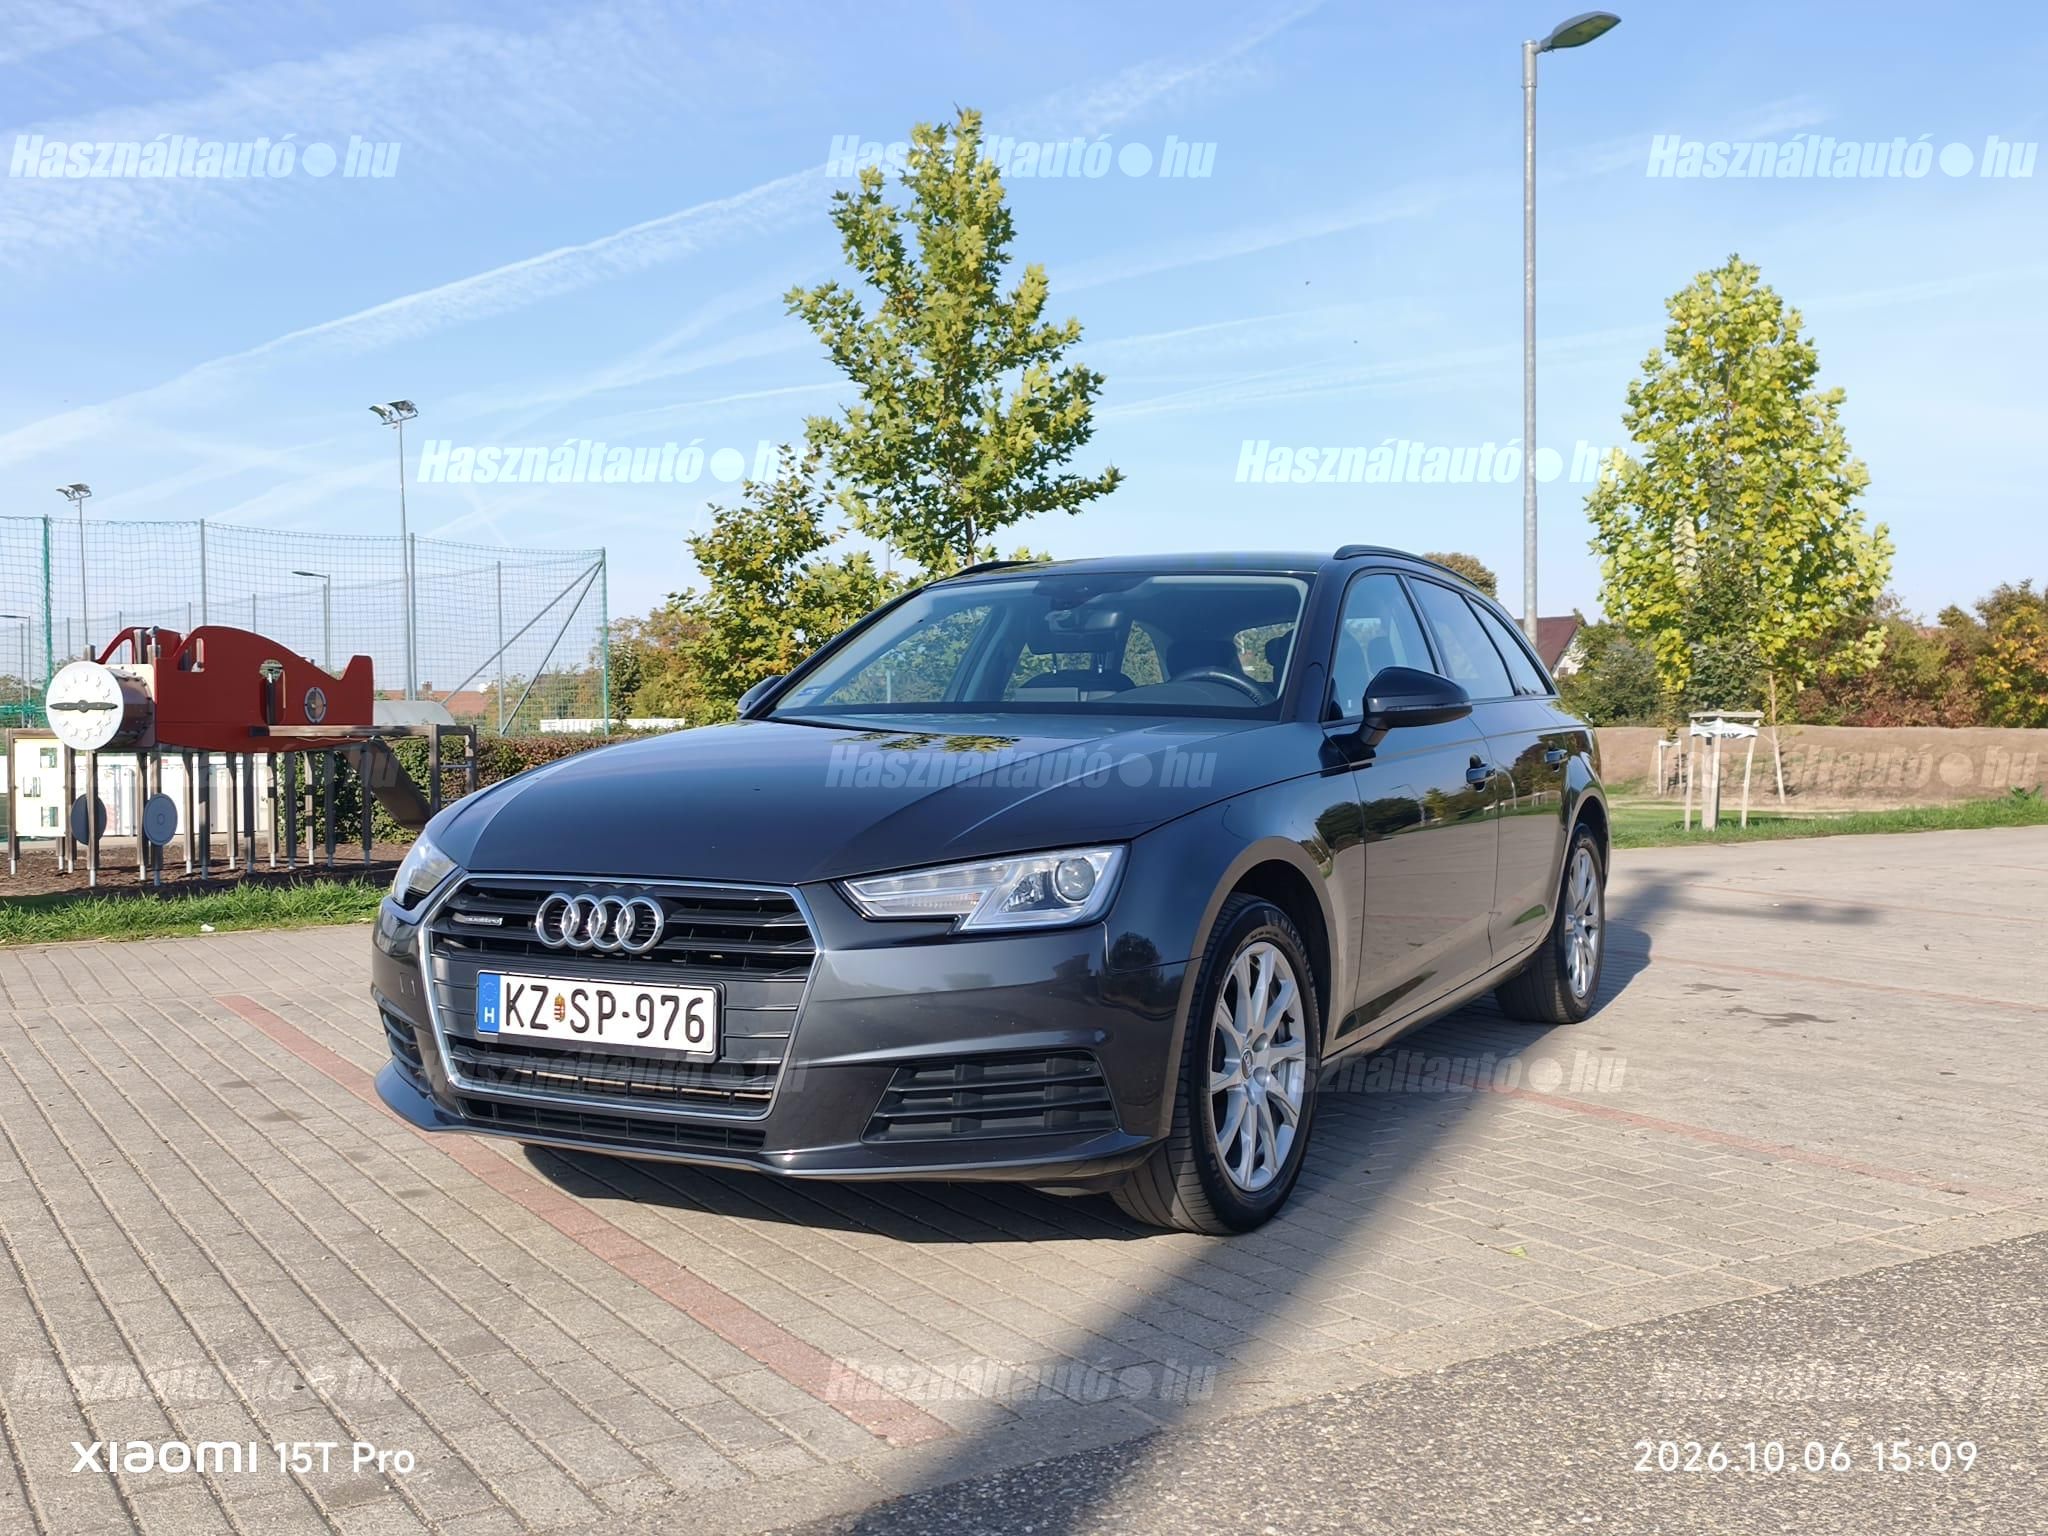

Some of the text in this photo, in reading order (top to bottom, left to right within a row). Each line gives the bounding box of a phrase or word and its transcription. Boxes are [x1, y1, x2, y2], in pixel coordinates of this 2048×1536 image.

[484, 1006, 495, 1023] H
[505, 982, 704, 1044] KZ SP-976
